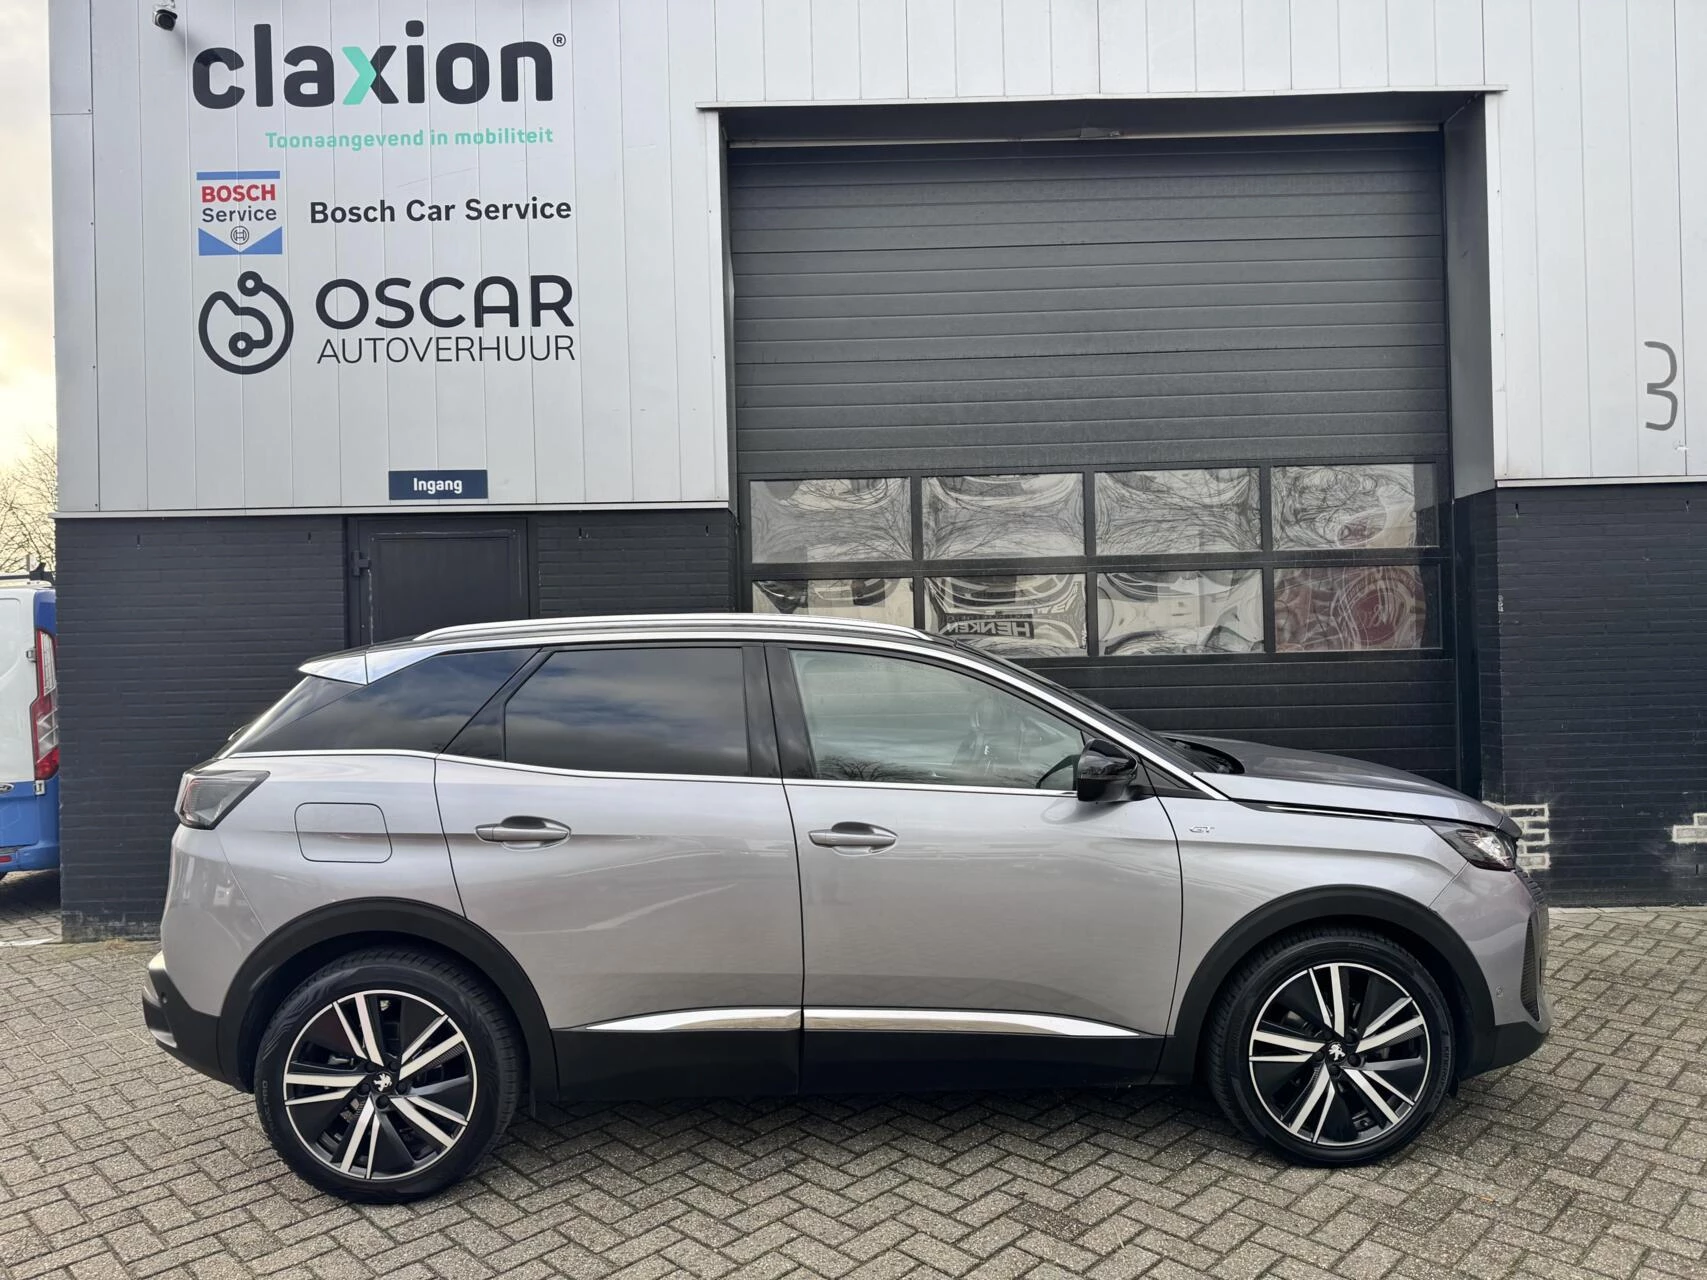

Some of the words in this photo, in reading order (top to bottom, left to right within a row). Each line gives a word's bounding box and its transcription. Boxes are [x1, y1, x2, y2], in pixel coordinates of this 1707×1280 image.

[265, 130, 424, 151] Toonaangevend
[431, 130, 446, 146] in
[454, 128, 554, 146] mobiliteit
[201, 184, 276, 203] BOSCH
[201, 205, 277, 223] Service
[310, 199, 396, 224] Bosch
[406, 200, 456, 222] Car
[465, 197, 572, 221] Service
[315, 274, 574, 330] OSCAR
[316, 335, 576, 364] AUTOVERHUUR
[1644, 341, 1678, 431] 3
[412, 477, 463, 494] Ingang
